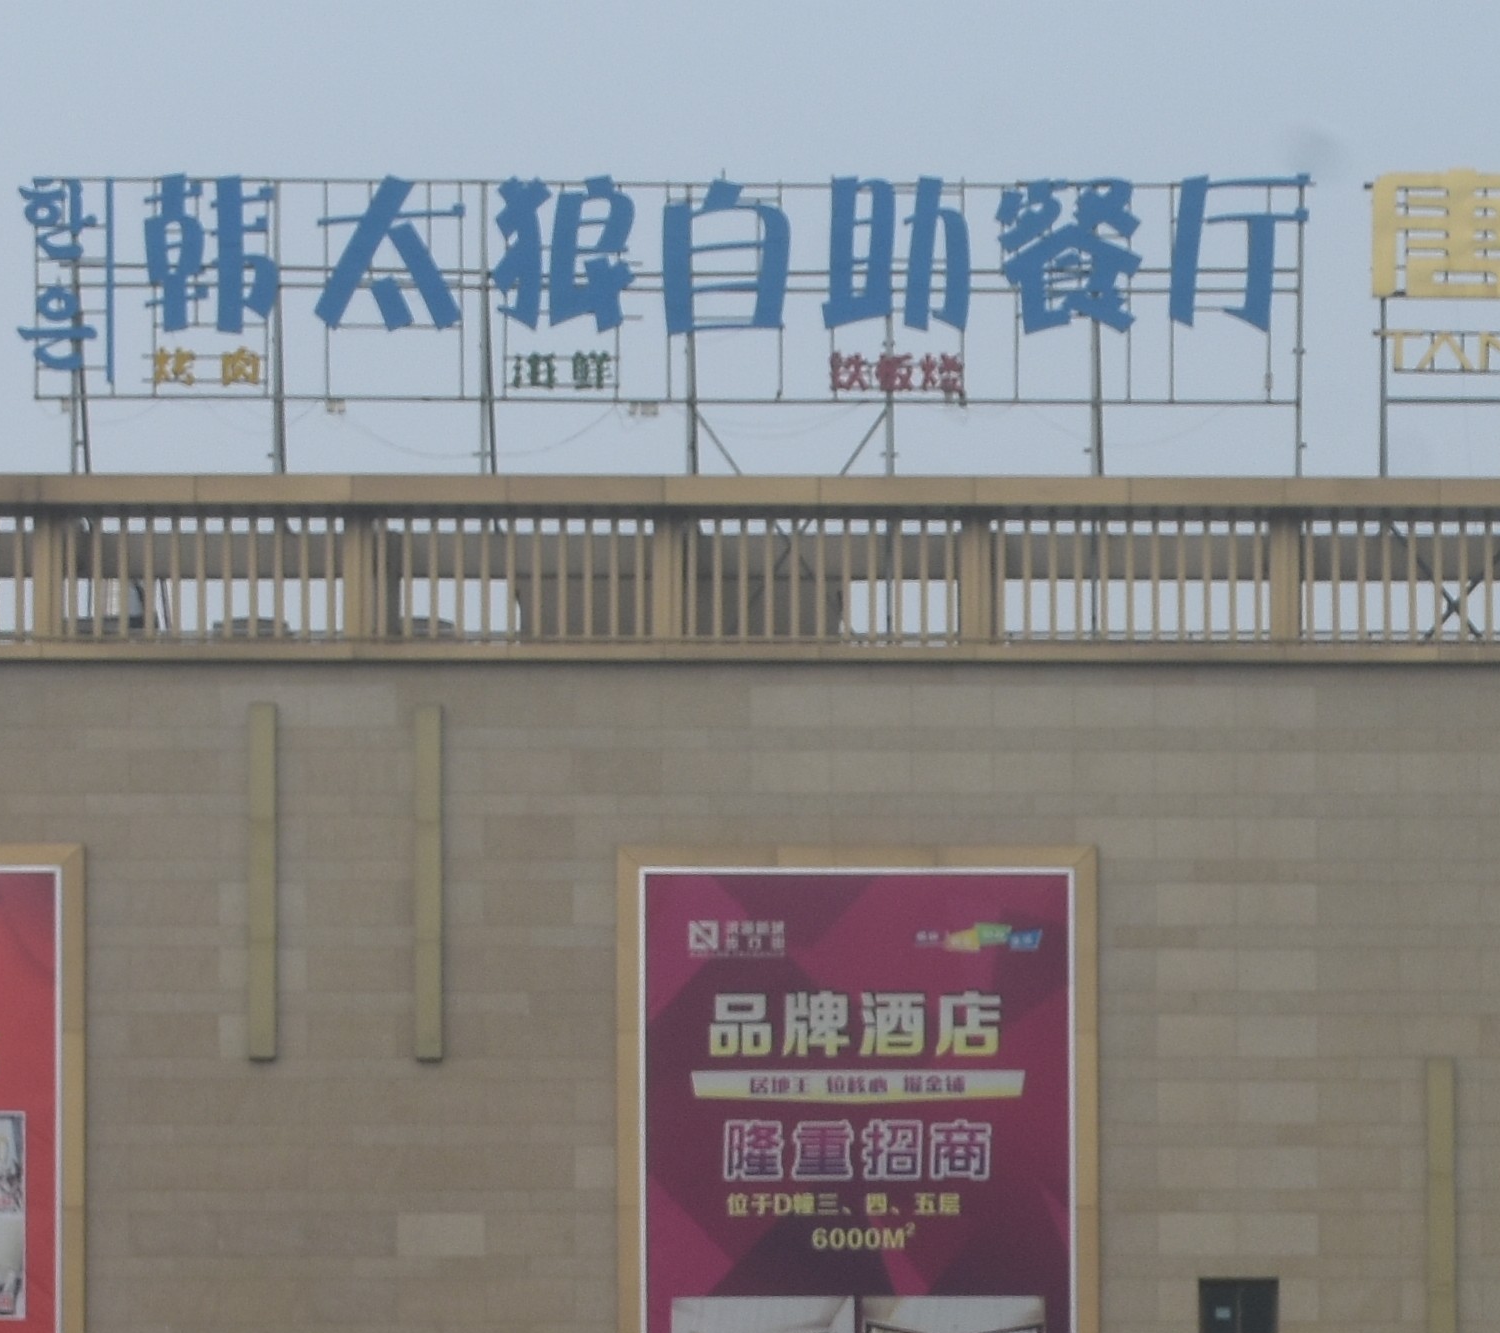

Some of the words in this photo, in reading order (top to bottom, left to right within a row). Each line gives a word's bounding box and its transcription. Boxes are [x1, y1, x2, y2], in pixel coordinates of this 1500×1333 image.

[143, 172, 1311, 335] 韩太狼自助餐厅
[153, 346, 262, 387] 烤肉
[708, 990, 1002, 1057] 品牌酒店
[723, 1119, 992, 1182] 隆重招商
